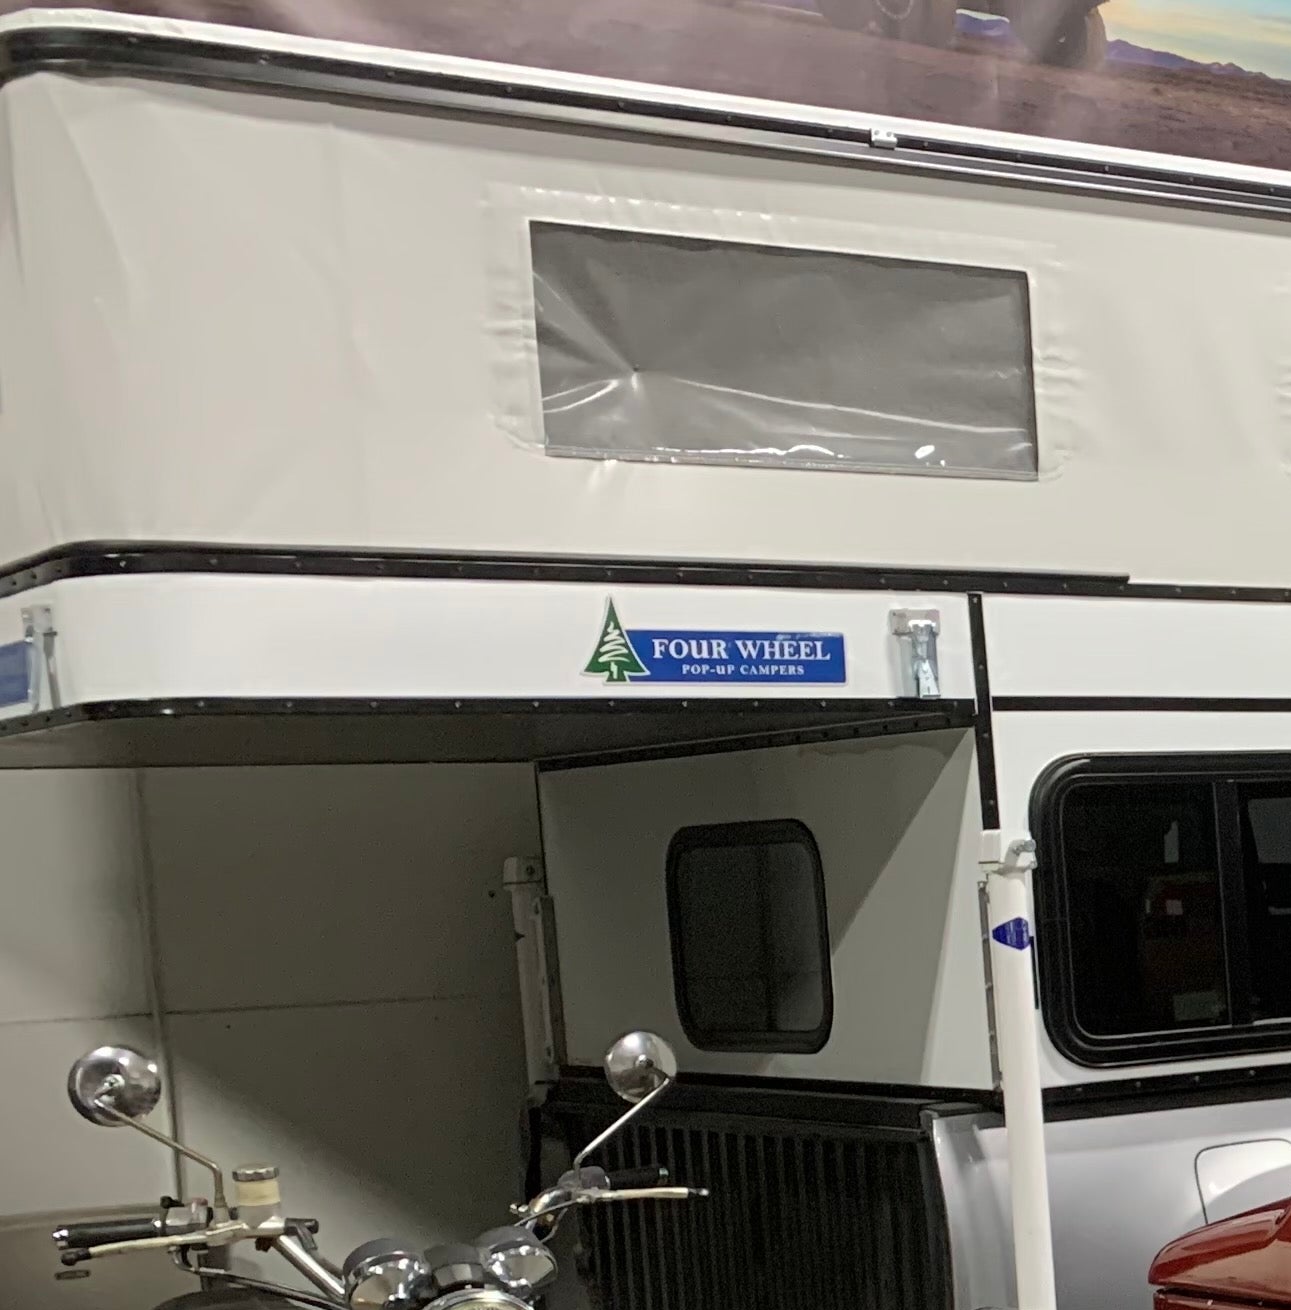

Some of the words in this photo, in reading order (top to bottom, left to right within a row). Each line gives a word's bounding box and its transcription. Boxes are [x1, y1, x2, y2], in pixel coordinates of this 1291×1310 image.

[652, 638, 729, 660] FOUR
[735, 640, 831, 661] WHEEL
[682, 664, 735, 675] POP-UP
[740, 664, 805, 676] CAMPERS
